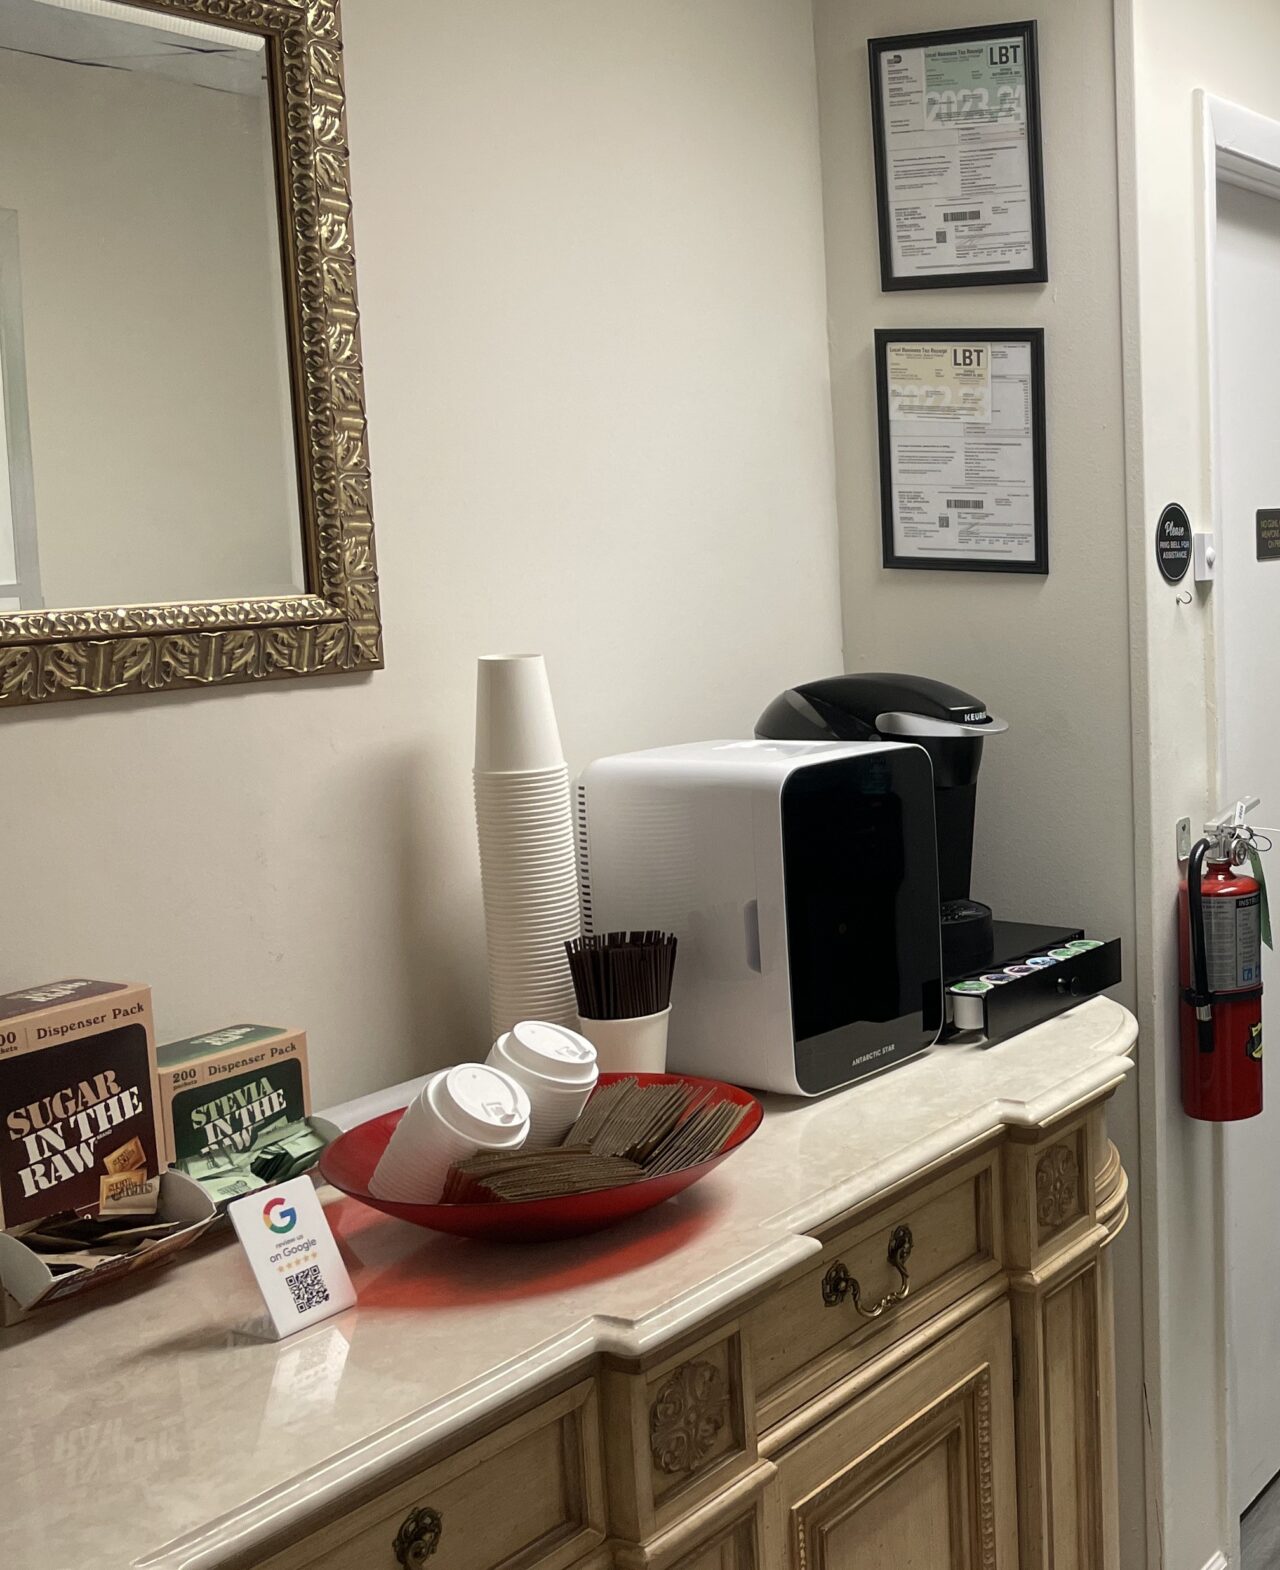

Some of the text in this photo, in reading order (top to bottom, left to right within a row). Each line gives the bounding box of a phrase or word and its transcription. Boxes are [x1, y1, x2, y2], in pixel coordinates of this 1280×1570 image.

[989, 44, 1021, 66] LBT
[953, 348, 984, 367] LBT
[1164, 520, 1185, 537] Please
[1170, 540, 1181, 549] BELL
[37, 1002, 144, 1040] Dispenser Pack
[172, 1042, 297, 1084] 200 Dispenser Pack
[852, 1043, 896, 1067] ANTARCTIC STAR
[7, 1070, 122, 1141] SUGAR
[191, 1077, 274, 1131] STEVIA
[204, 1088, 287, 1145] IN THE
[22, 1122, 66, 1164] IN
[70, 1086, 143, 1141] THE
[18, 1137, 97, 1198] RAW
[269, 1238, 317, 1263] on Google
[275, 1237, 296, 1249] review
